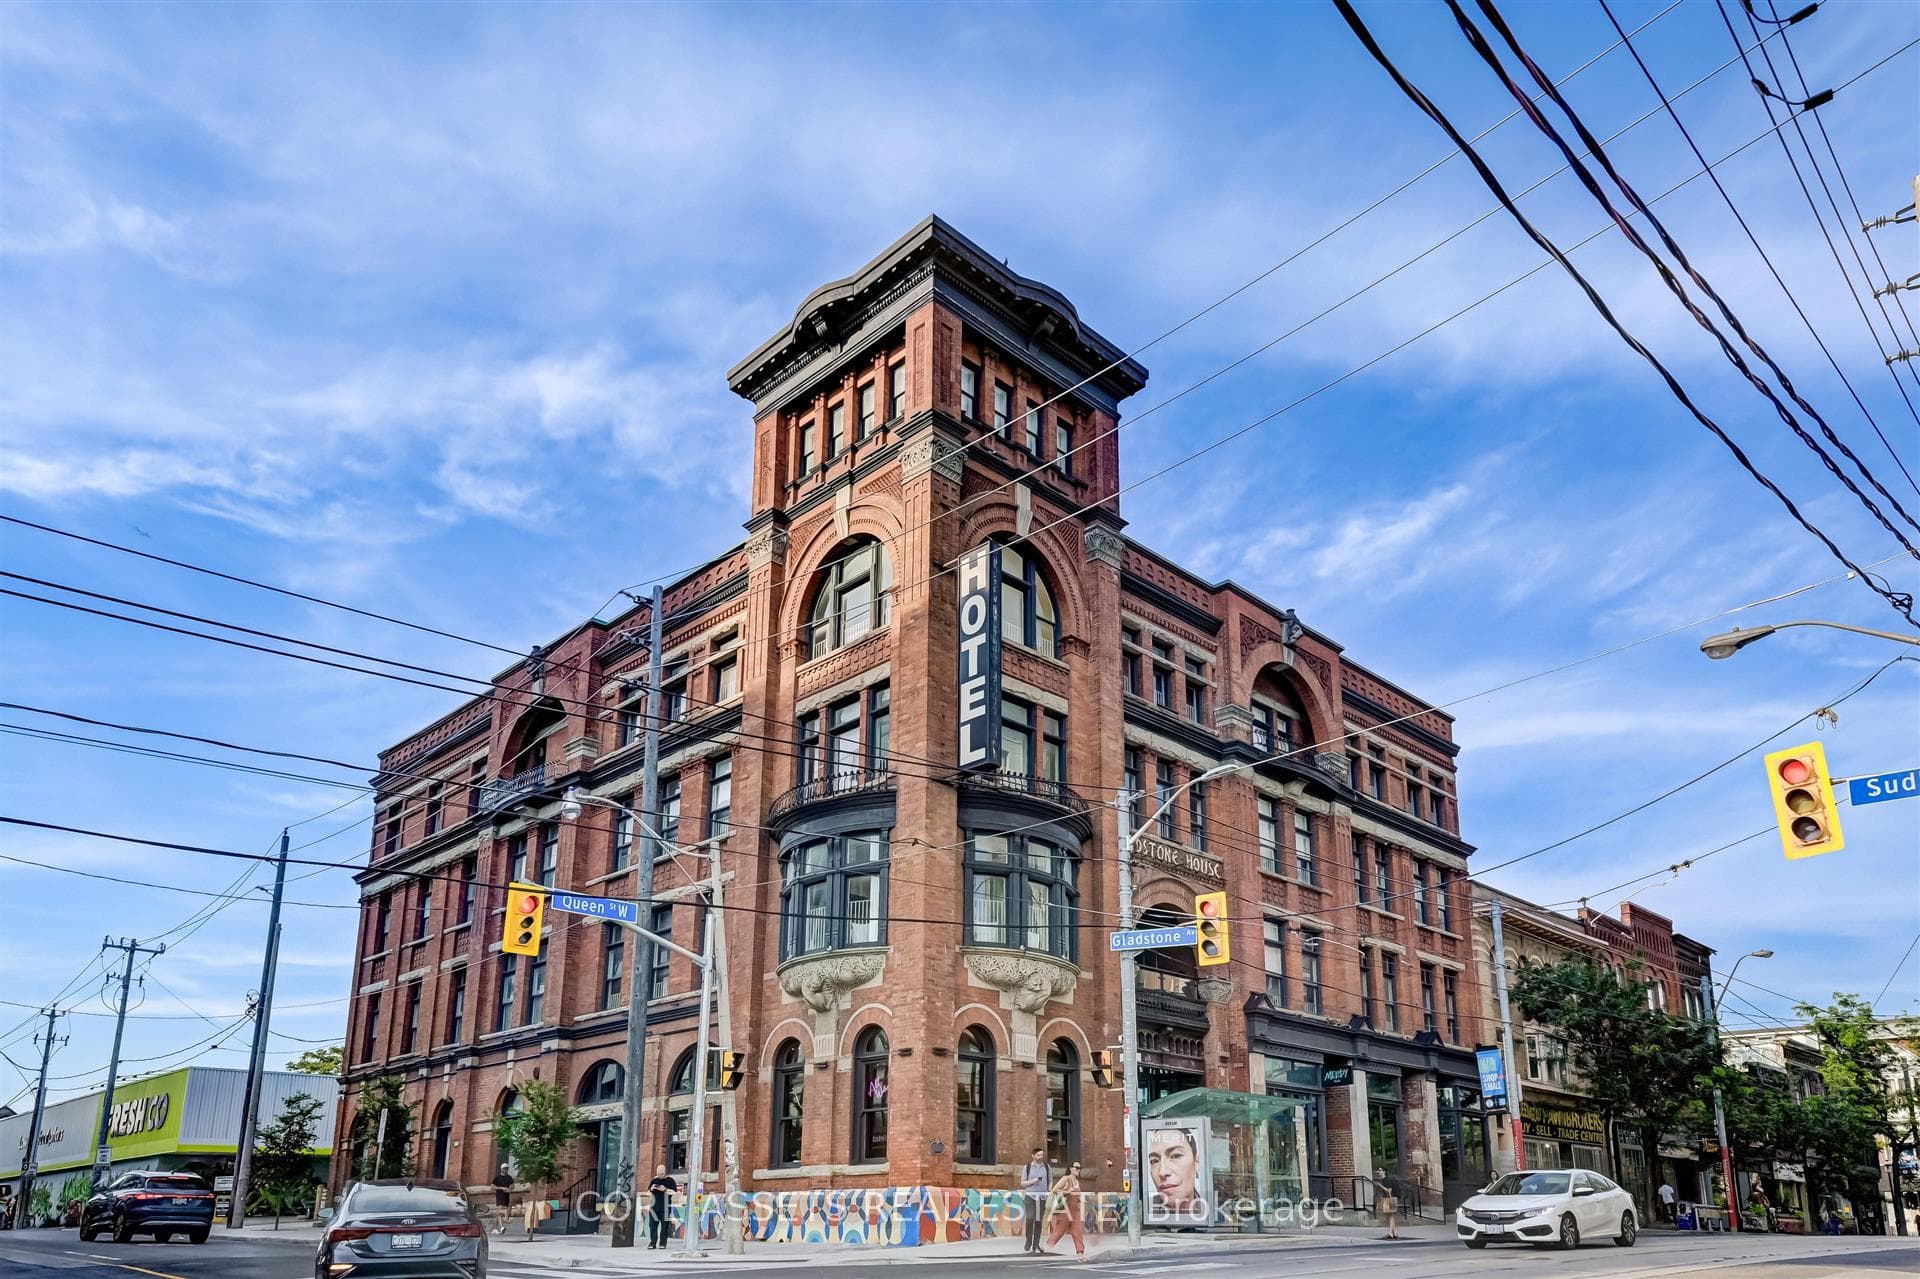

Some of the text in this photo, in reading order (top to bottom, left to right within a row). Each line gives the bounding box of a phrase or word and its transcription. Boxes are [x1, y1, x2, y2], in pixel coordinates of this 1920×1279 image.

[960, 548, 987, 767] HOTEL
[1866, 771, 1920, 797] Sud
[1135, 839, 1179, 865] DSTONE
[562, 896, 628, 918] Queen St W
[1112, 932, 1181, 947] Gladstone
[1521, 1122, 1531, 1135] UY
[1536, 1124, 1553, 1137] SELL
[1557, 1126, 1580, 1141] TRADE
